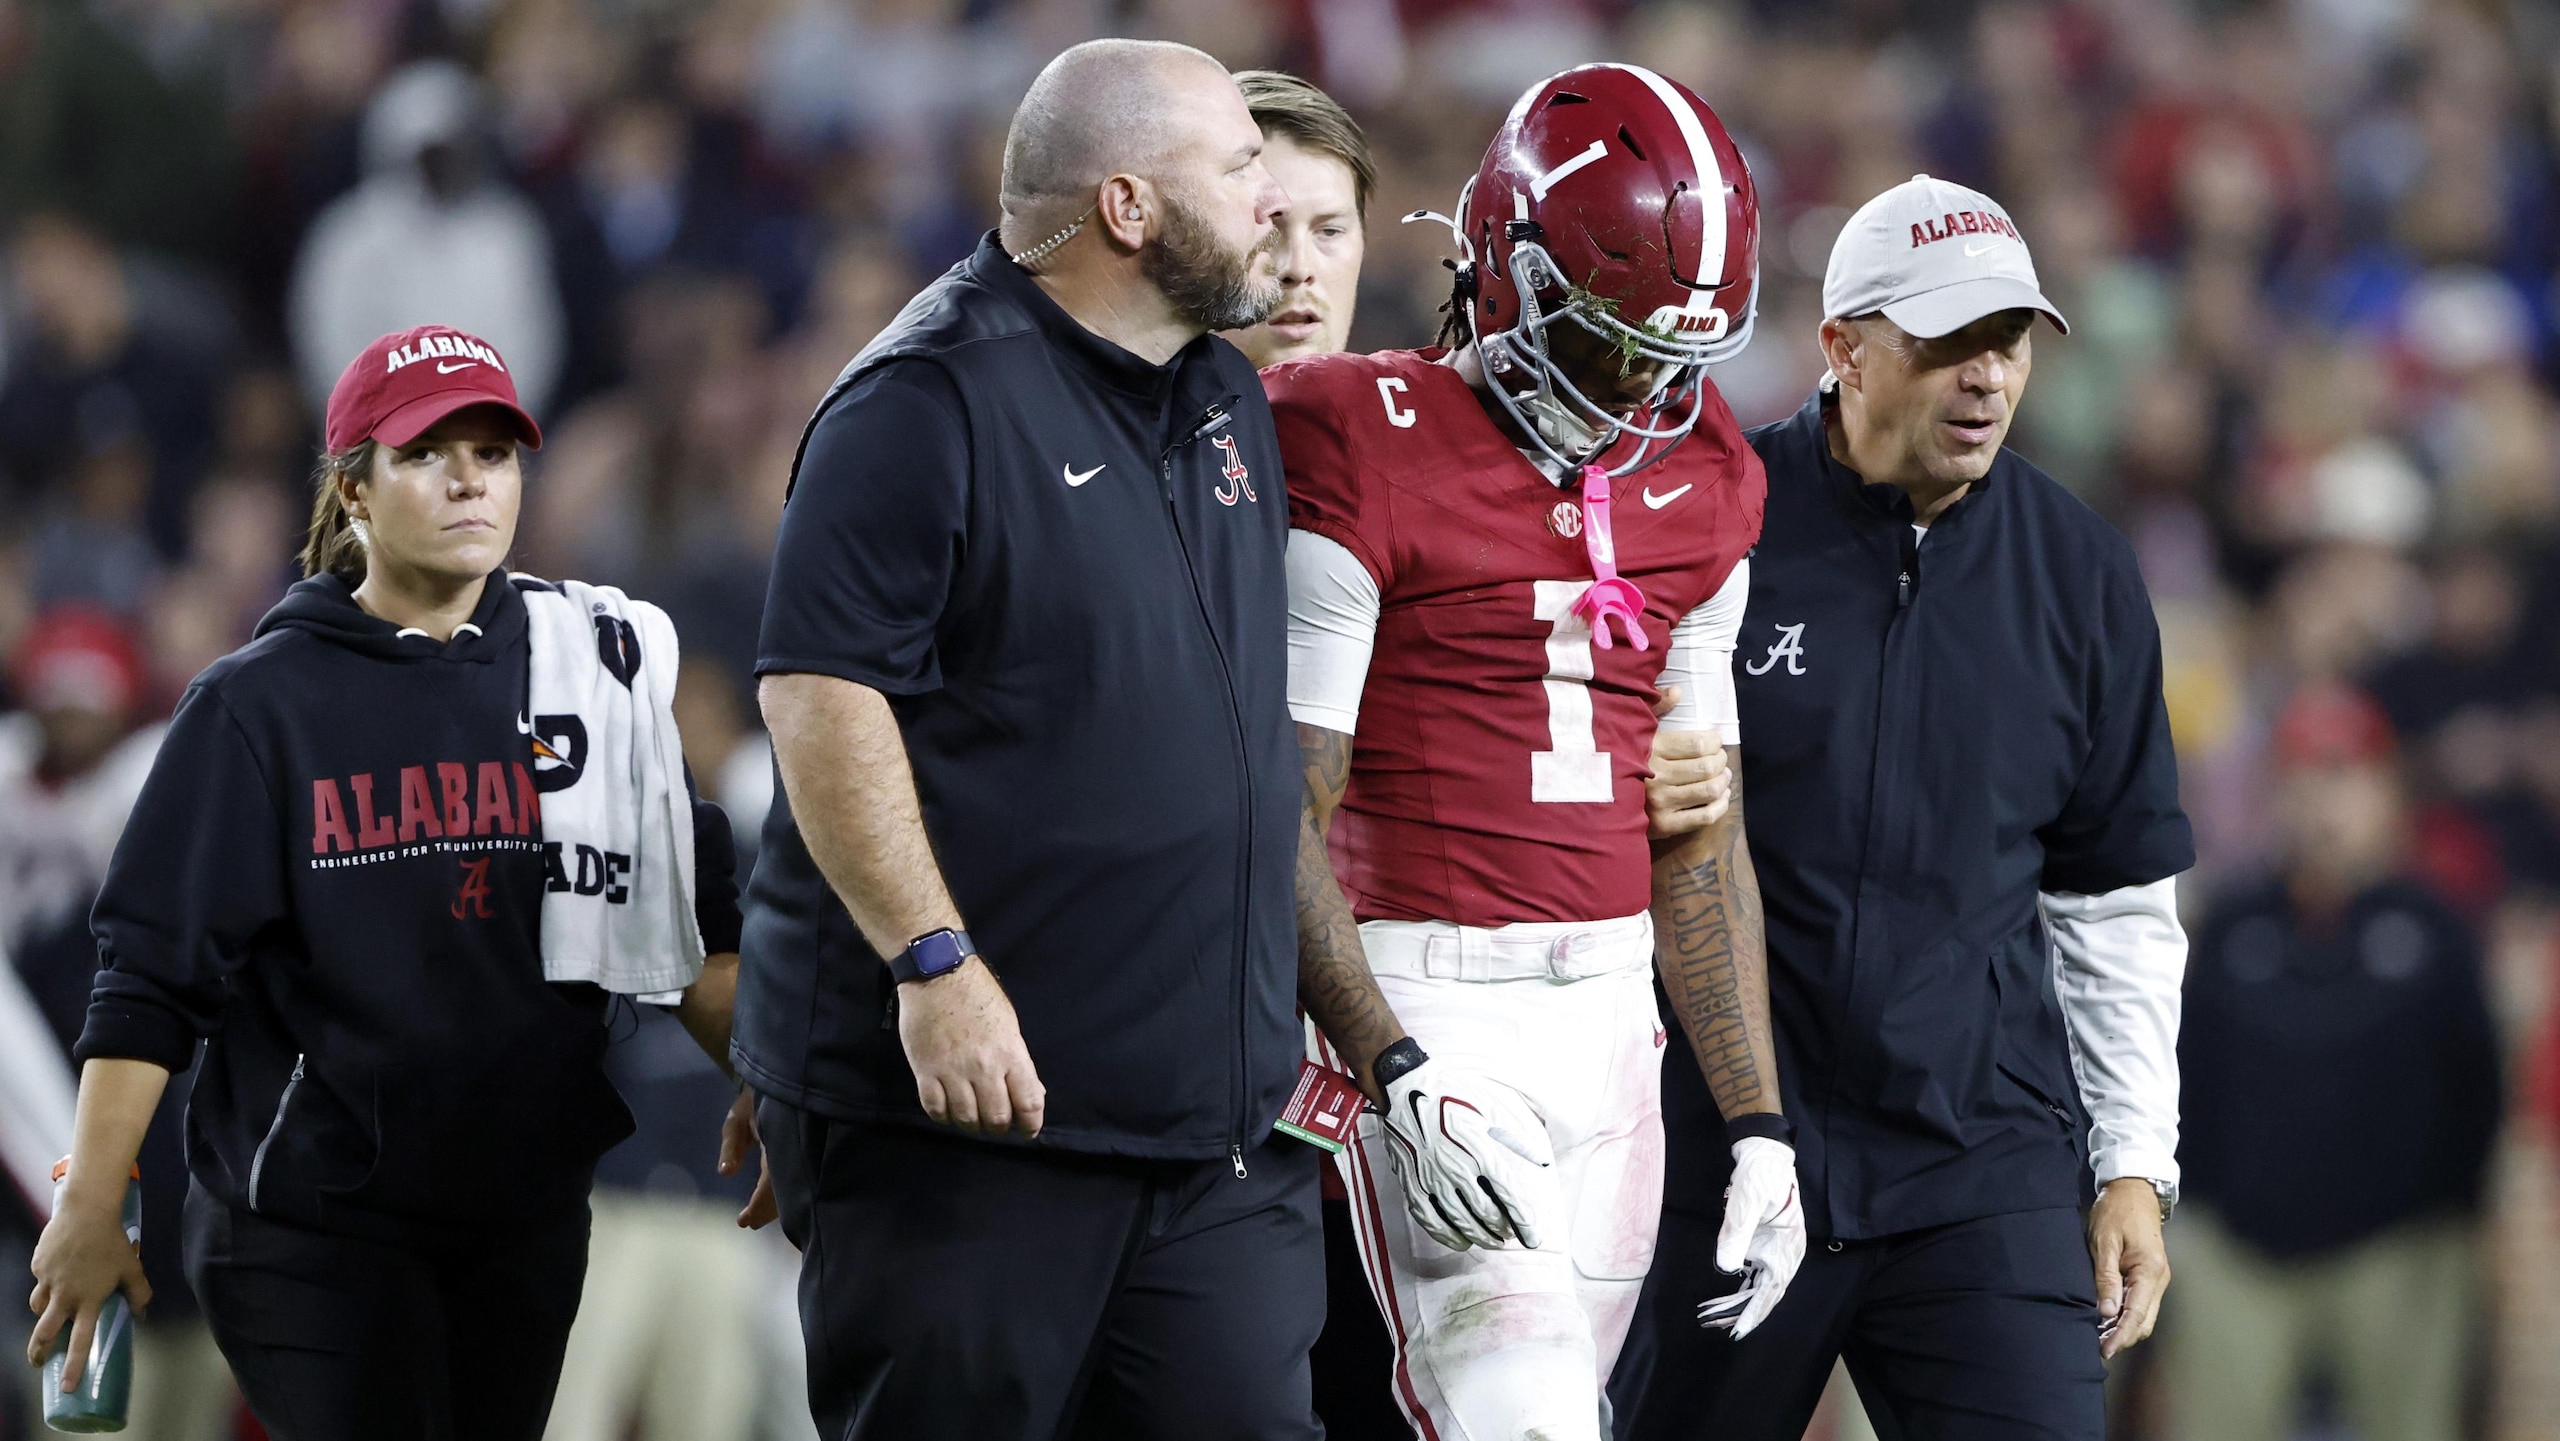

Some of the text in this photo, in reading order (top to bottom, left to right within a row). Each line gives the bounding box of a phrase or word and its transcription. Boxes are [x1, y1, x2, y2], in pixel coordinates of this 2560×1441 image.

[1529, 139, 1609, 204] 1
[386, 335, 506, 374] ALABAMA
[1376, 376, 1417, 429] C
[1211, 434, 1258, 506] A
[1552, 501, 1583, 538] SEC
[1745, 622, 1807, 676] A
[1530, 579, 1615, 803] 1
[310, 850, 396, 869] ENGINEERED
[403, 846, 428, 858] FOR
[435, 842, 452, 852] TH
[453, 839, 528, 852] UNIVERSITY
[1693, 1001, 1762, 1119] KEEPER
